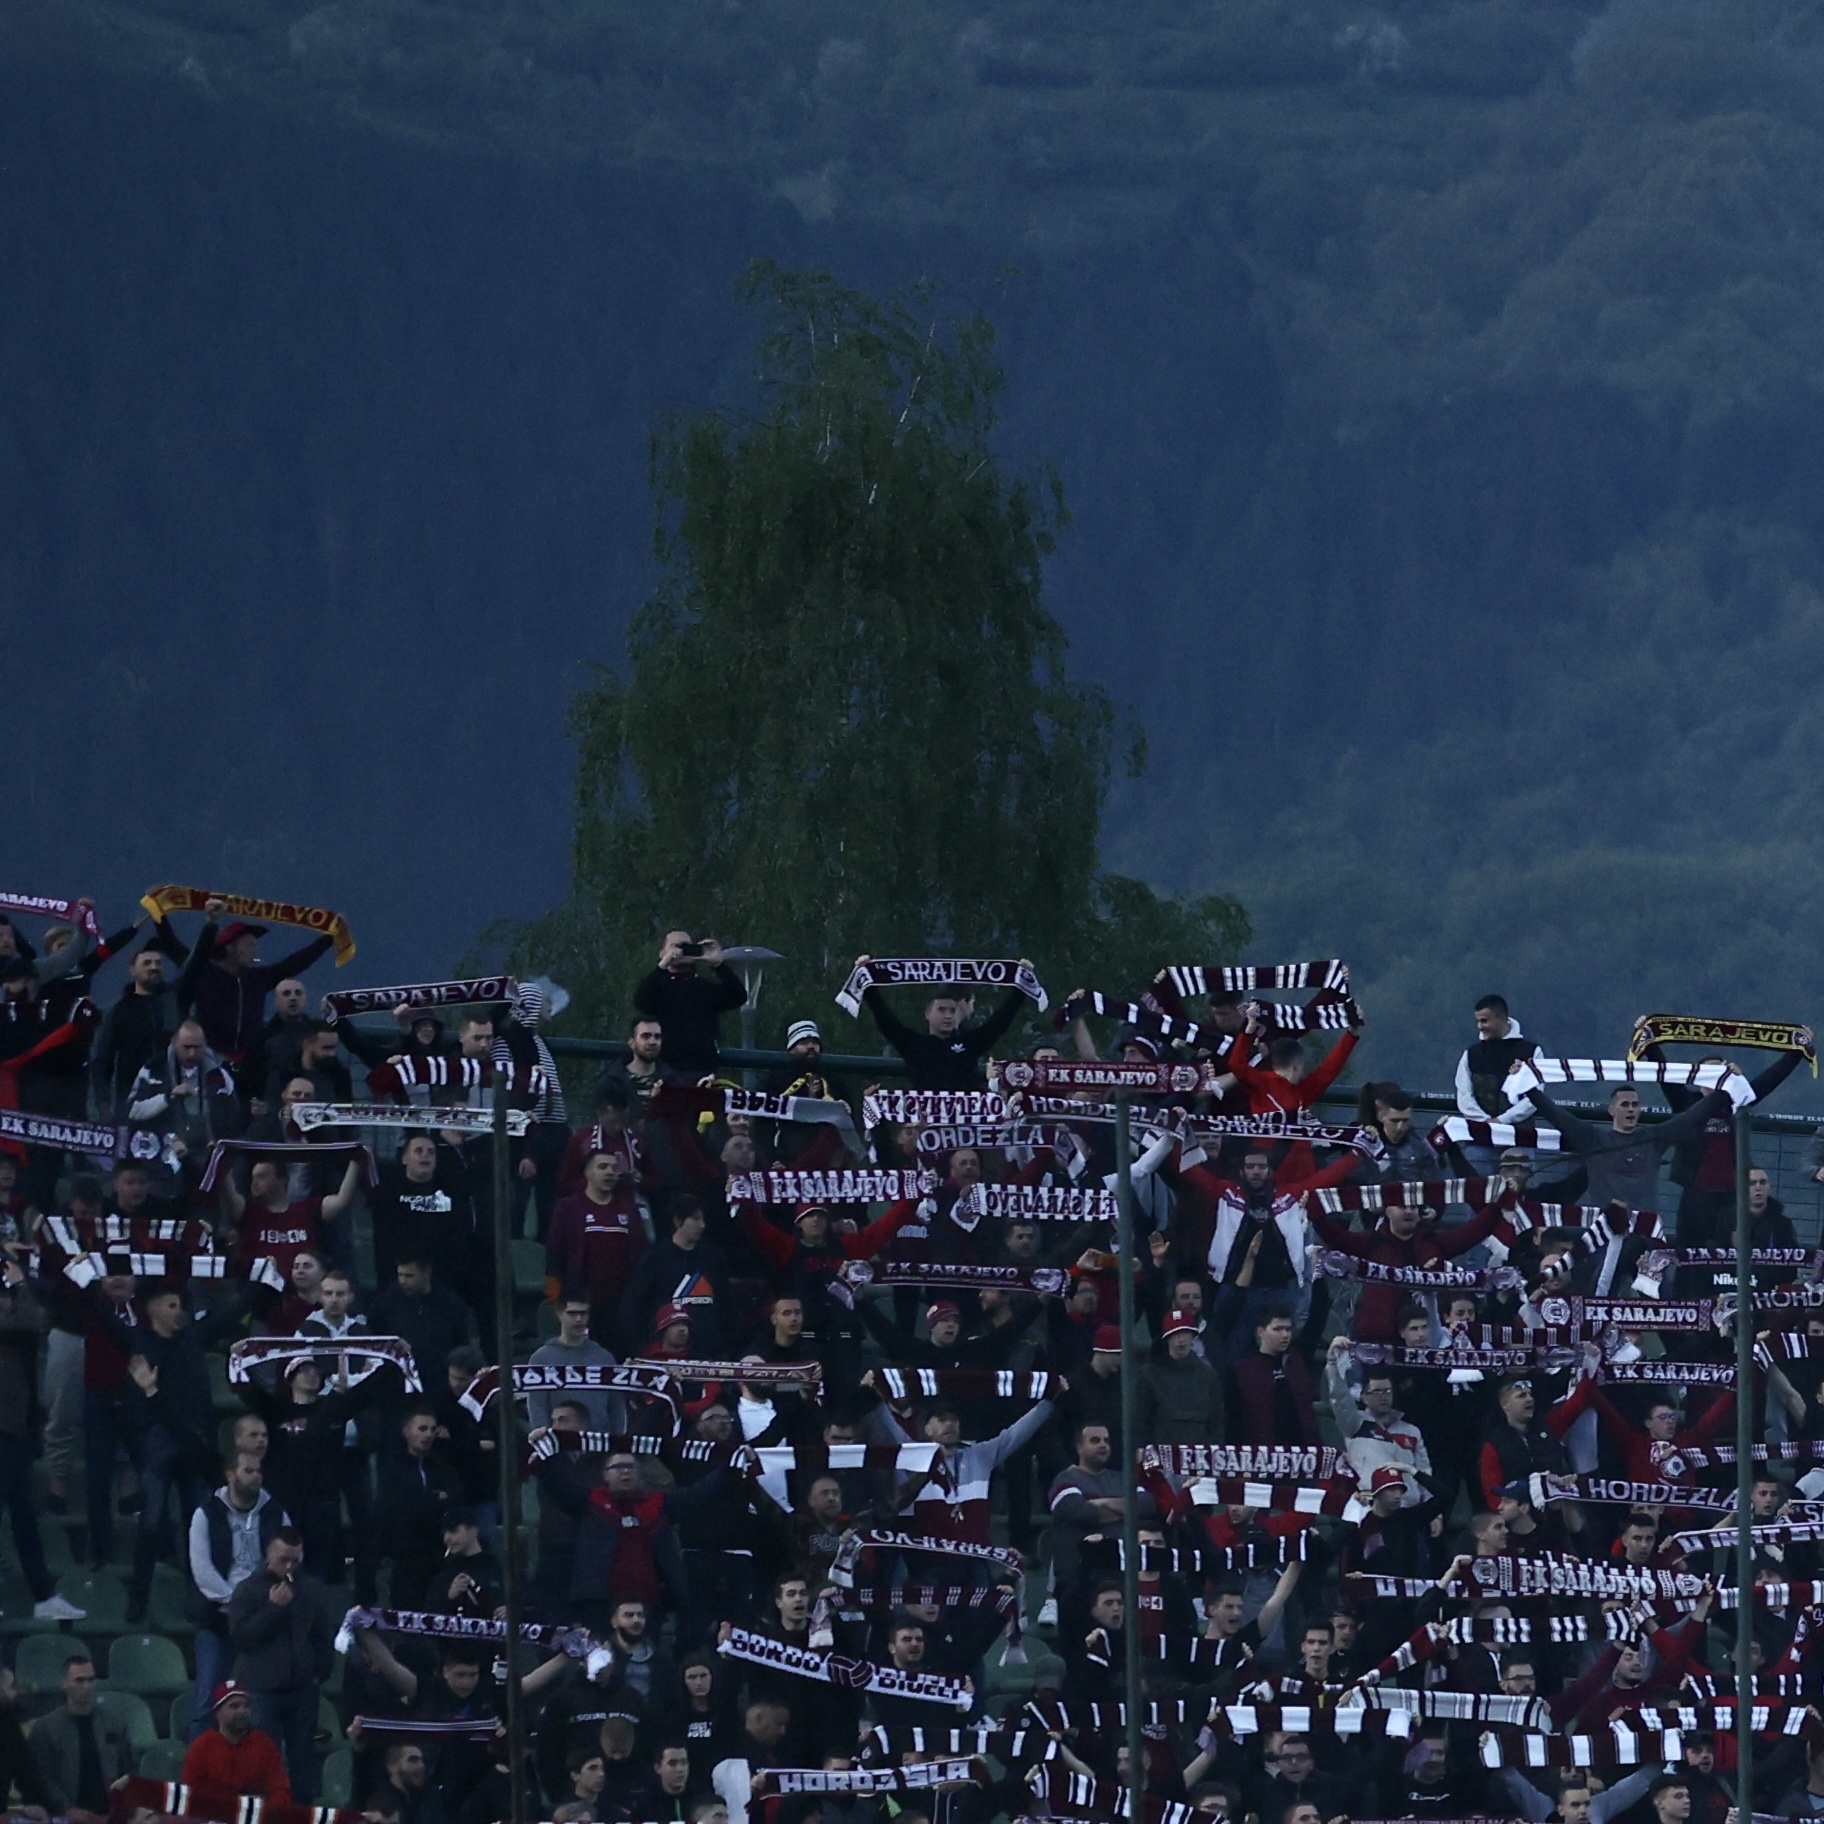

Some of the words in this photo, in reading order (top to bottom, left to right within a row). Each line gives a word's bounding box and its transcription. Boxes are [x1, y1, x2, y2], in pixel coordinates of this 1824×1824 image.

[887, 960, 1006, 982] SARAJEVO
[350, 980, 499, 1009] SARAJEVO
[1658, 1022, 1790, 1047] SARAJEVO
[1072, 1070, 1157, 1086] SARAJEVO
[27, 1118, 115, 1148] SARAJEVO
[802, 1173, 898, 1200] SARAJEVO
[1717, 1246, 1805, 1263] SAAJEVO
[1611, 1305, 1698, 1325] SARAJEVO
[1433, 1348, 1526, 1367] SARAJEVO
[1641, 1364, 1734, 1386] SARAJEVO
[1215, 1448, 1317, 1475] SARAJEVO
[1552, 1564, 1657, 1597] SARAJEVO
[731, 1628, 821, 1675] BORDO
